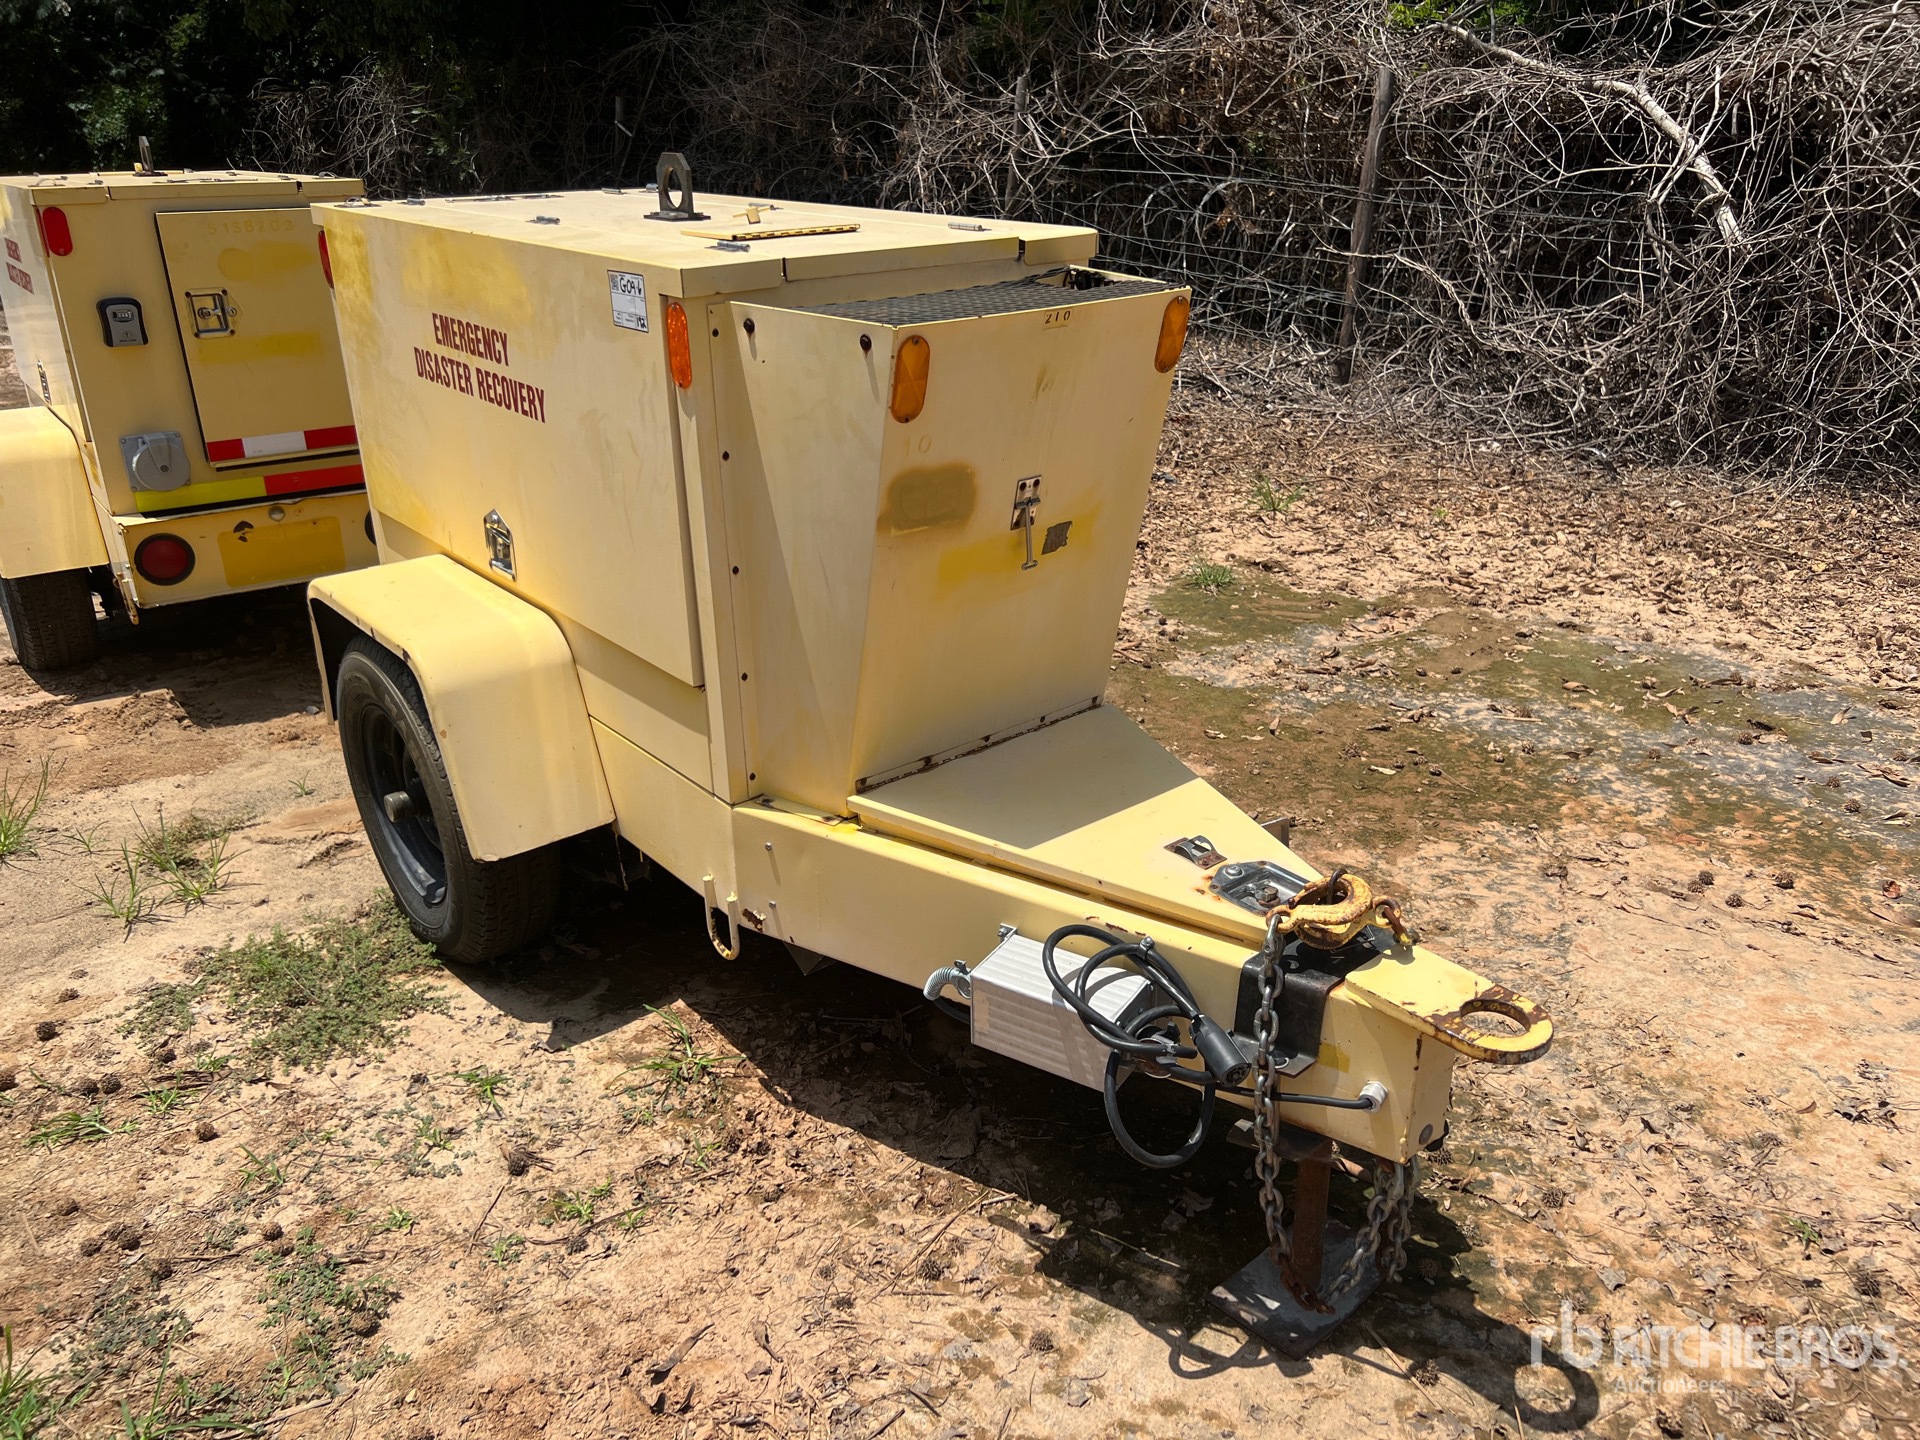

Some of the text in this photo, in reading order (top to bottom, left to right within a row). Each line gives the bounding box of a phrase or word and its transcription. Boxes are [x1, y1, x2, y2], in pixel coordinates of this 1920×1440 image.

[432, 312, 509, 367] EMERGENCY
[1045, 310, 1071, 325] 210
[413, 346, 546, 424] DISASTER RECOVERY
